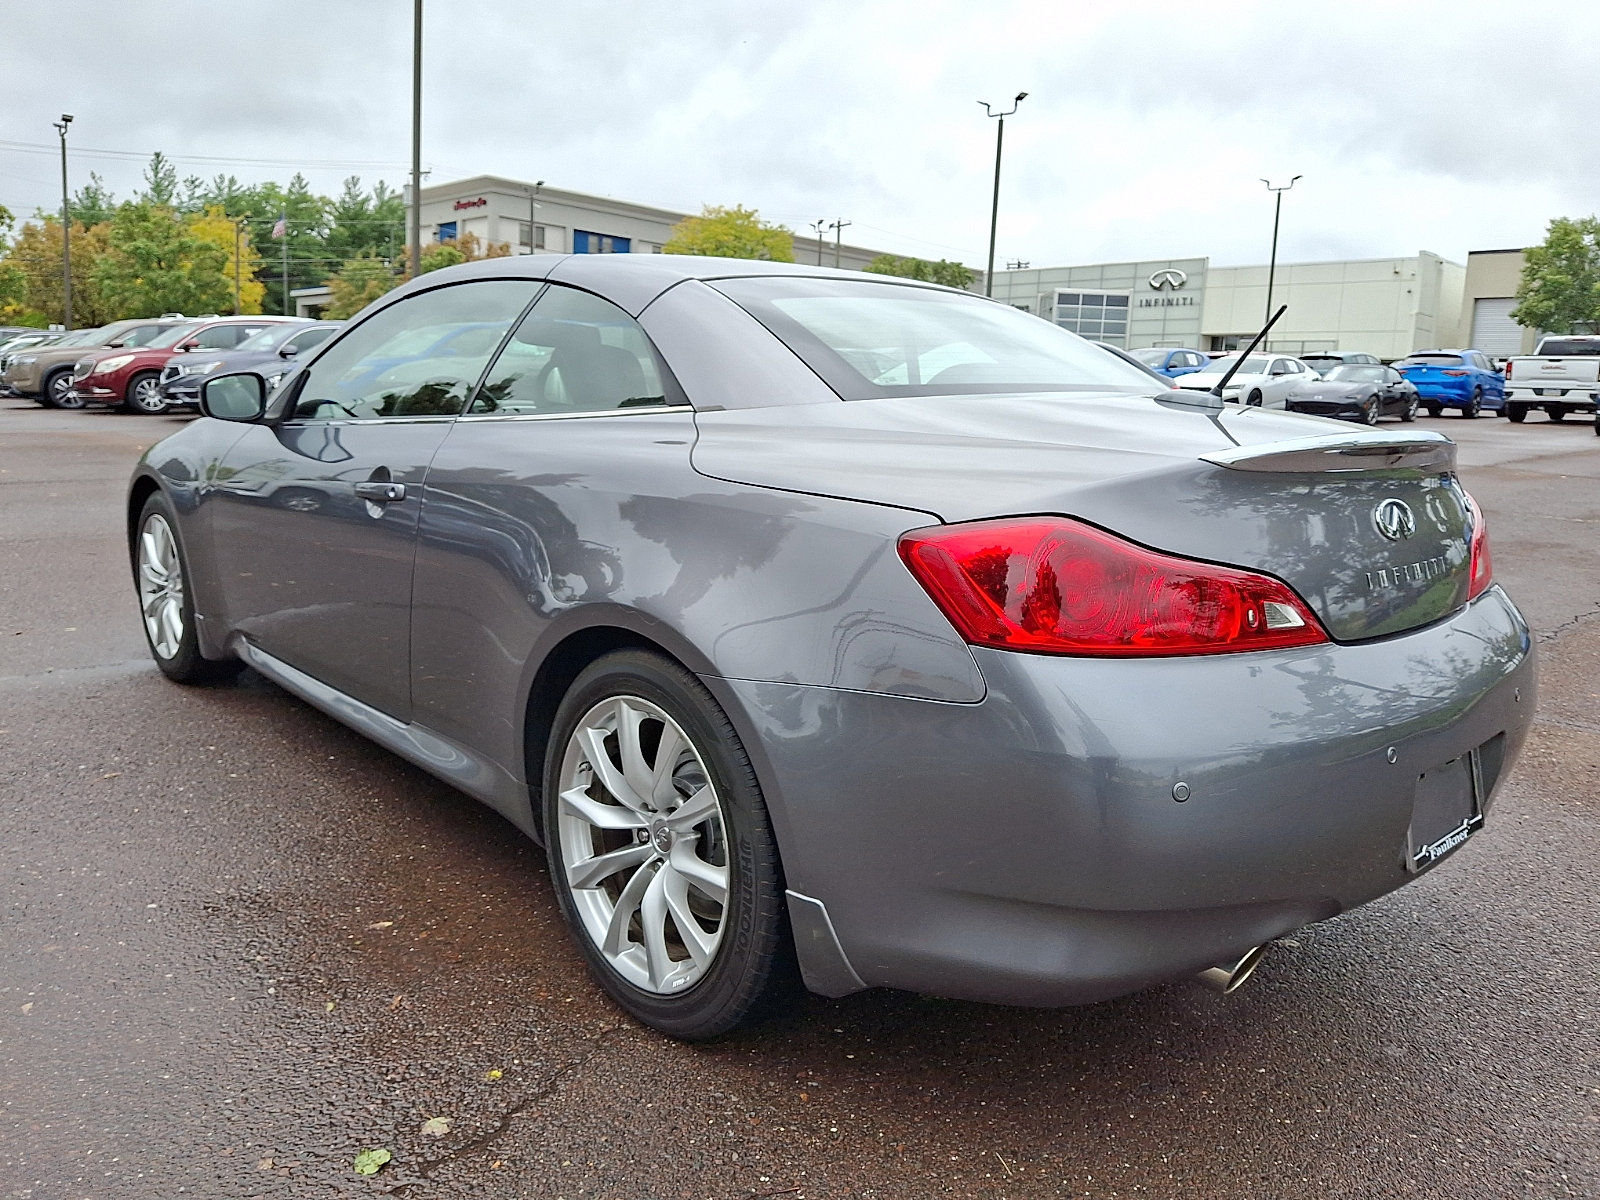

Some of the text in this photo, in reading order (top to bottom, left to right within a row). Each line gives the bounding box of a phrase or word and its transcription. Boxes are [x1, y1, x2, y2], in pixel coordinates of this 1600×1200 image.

[1140, 297, 1194, 308] INFINITI
[1366, 556, 1447, 590] INFINITI
[1428, 828, 1469, 861] Faulkner
